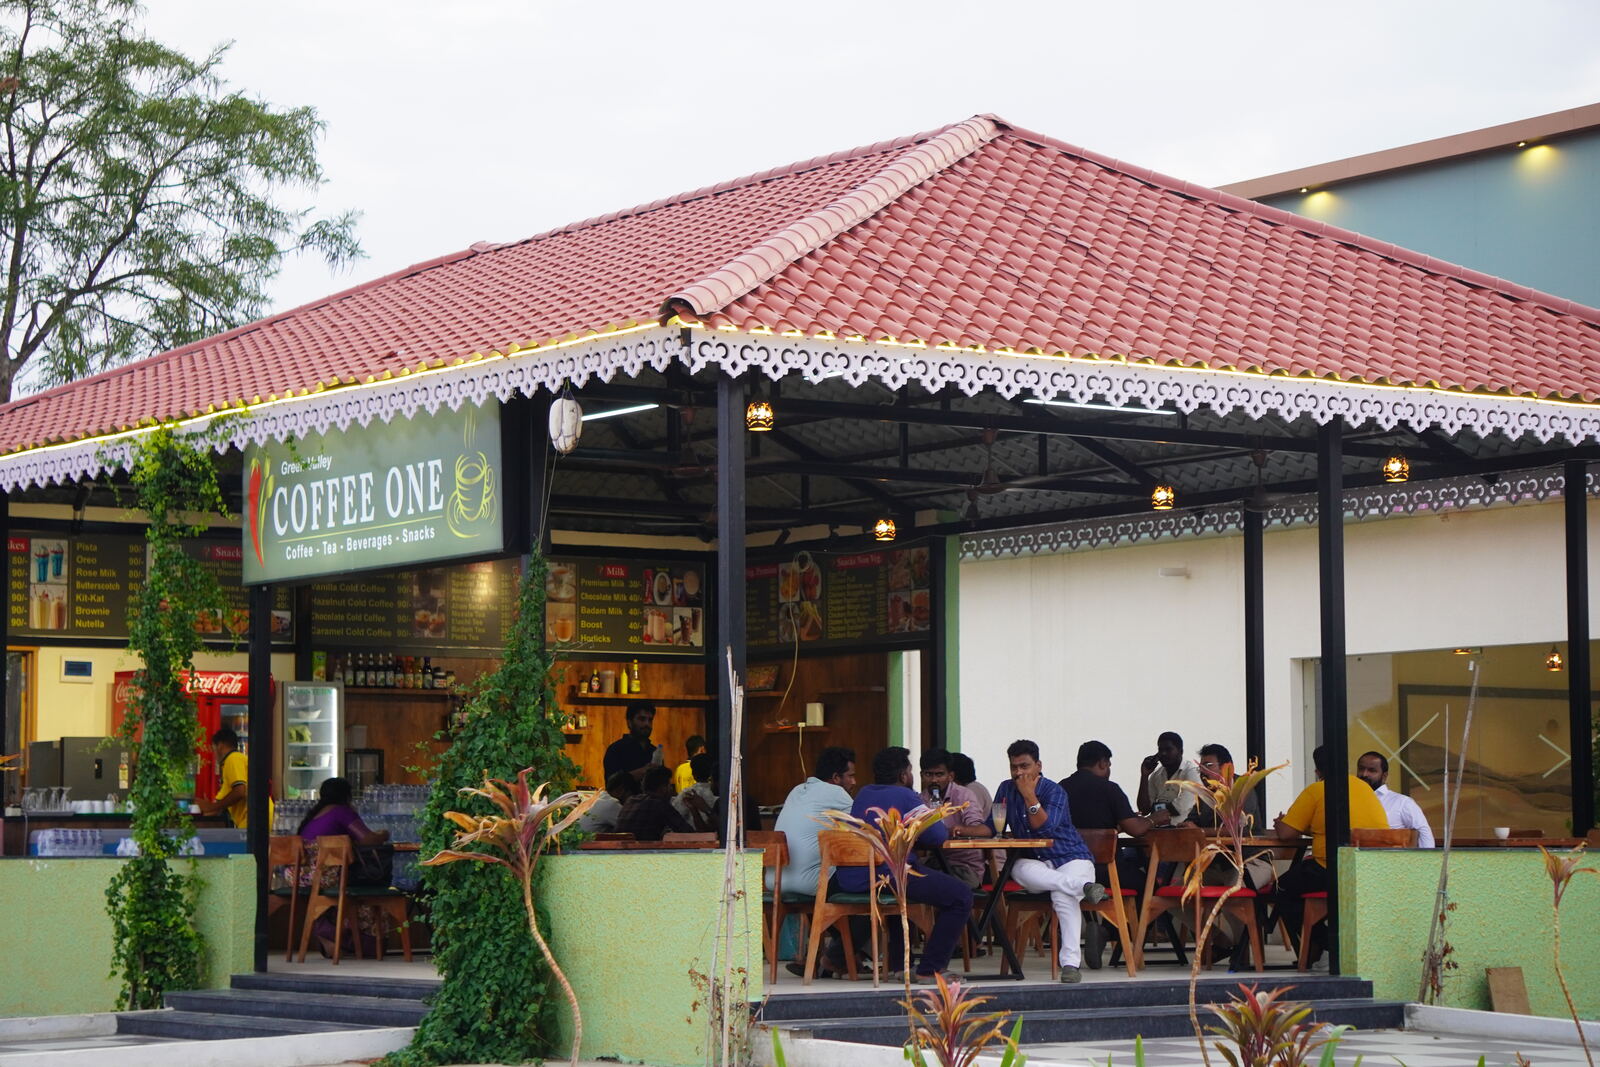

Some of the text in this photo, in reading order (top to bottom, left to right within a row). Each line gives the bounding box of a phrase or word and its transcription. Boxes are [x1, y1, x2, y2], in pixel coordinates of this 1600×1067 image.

[273, 458, 444, 536] COFFEE ONE
[286, 543, 313, 560] Coffee
[322, 541, 337, 555] Tea
[346, 534, 392, 552] Beverages
[402, 525, 435, 544] Snacks
[76, 543, 97, 552] Pista
[215, 547, 242, 558] Snack
[76, 555, 97, 564] Oreo
[76, 568, 97, 577] Rose
[100, 568, 117, 577] Milk
[606, 566, 625, 576] Milk
[76, 582, 120, 591] Butterscotch
[76, 594, 104, 603] Kit-Kat
[11, 606, 27, 614] 90/-
[76, 606, 110, 615] Brownie
[581, 607, 606, 615] Badam
[608, 607, 623, 616] Milk
[11, 618, 27, 627] 90/-
[75, 619, 105, 628] Nutella
[581, 620, 602, 629] Boost
[581, 634, 642, 644] Horlicks 40/-
